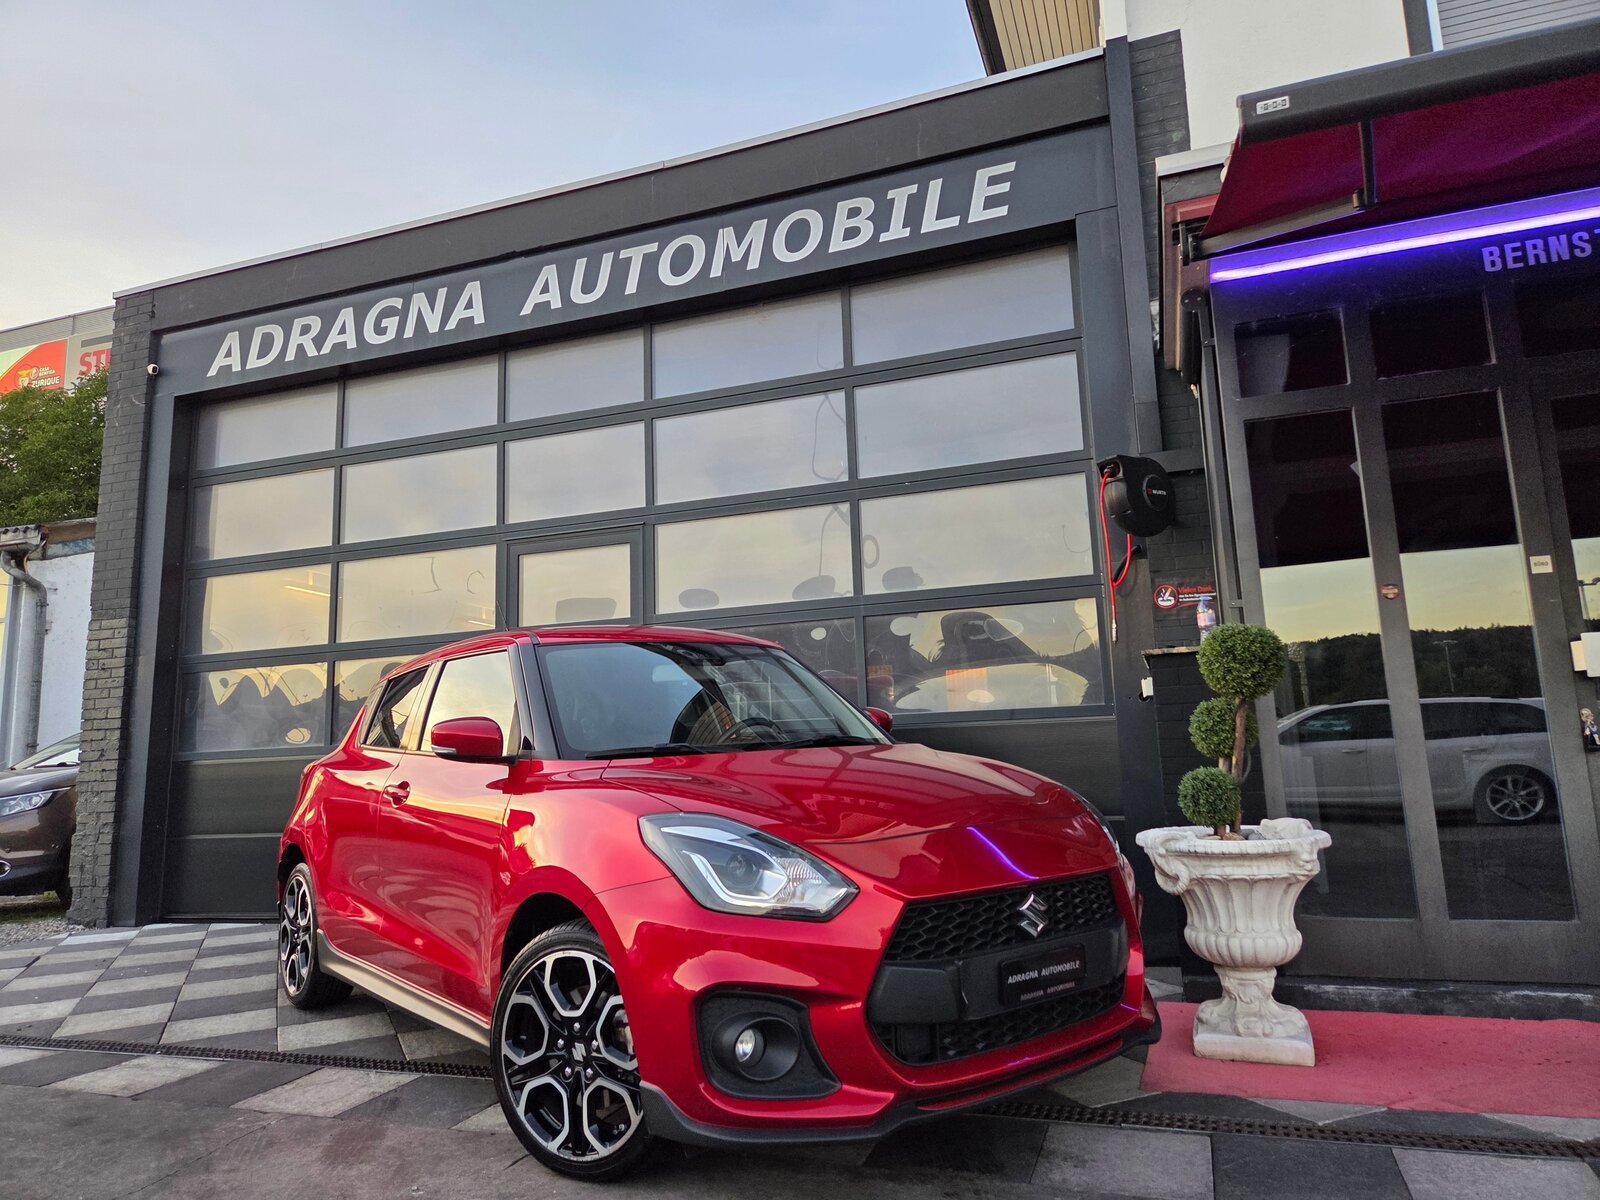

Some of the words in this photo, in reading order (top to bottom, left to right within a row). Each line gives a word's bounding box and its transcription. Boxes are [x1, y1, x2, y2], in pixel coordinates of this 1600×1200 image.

[207, 281, 486, 377] ADRAGNA
[521, 161, 1017, 317] AUTOMOBILE
[1007, 970, 1039, 984] ADRAGNA
[1041, 960, 1080, 976] AUTOMOBILE
